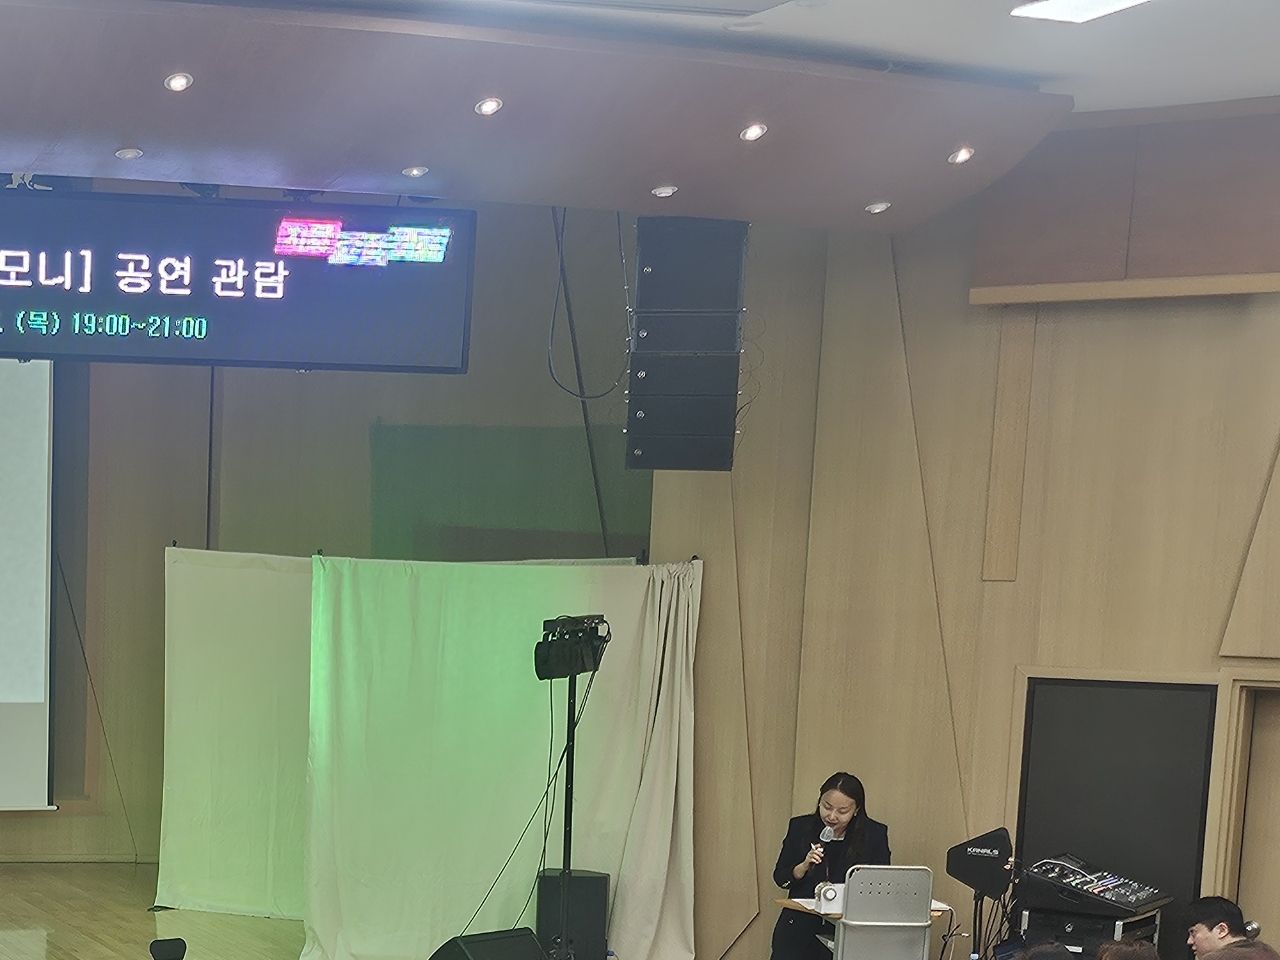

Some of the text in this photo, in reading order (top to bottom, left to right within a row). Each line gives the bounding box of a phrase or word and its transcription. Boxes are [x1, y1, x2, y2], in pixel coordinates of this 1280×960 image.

[115, 252, 193, 296] 공연
[211, 258, 290, 300] 관람
[15, 309, 61, 337] (목)
[72, 311, 208, 340] 19:00~21:00
